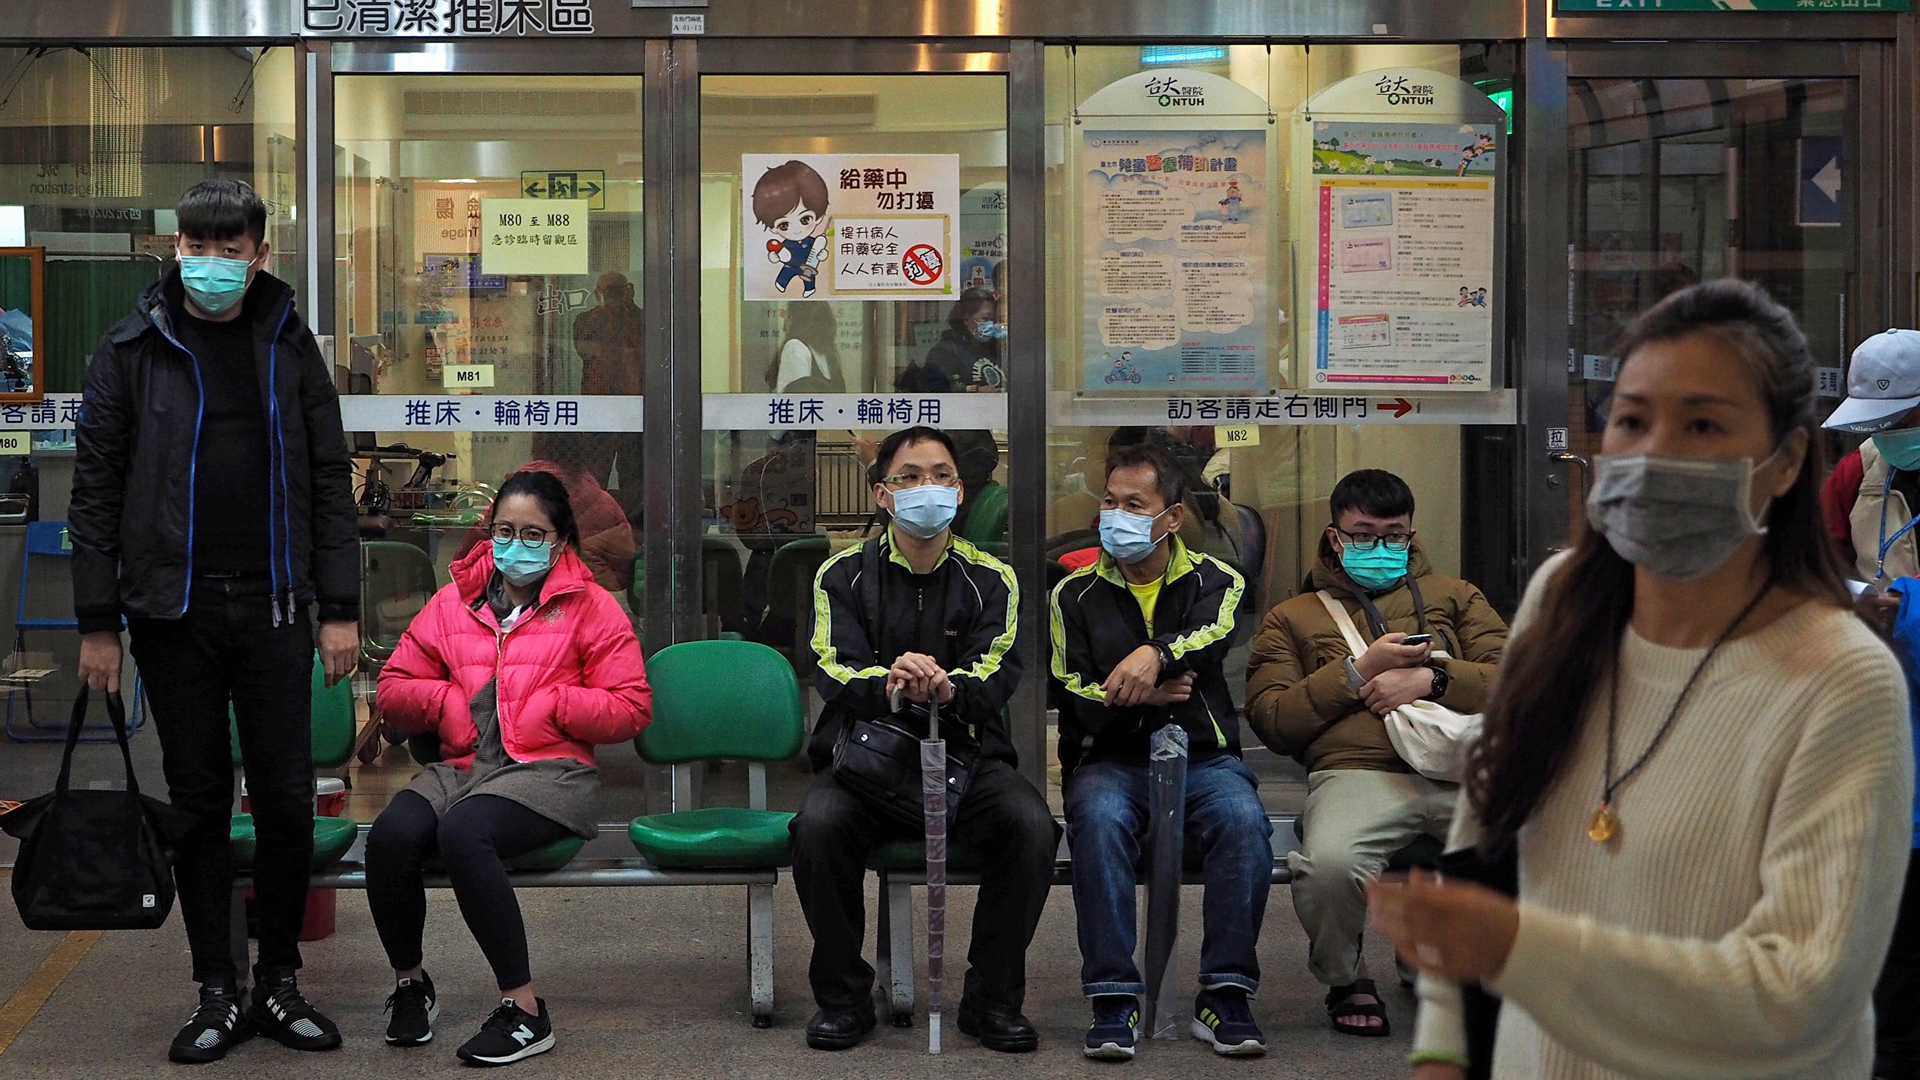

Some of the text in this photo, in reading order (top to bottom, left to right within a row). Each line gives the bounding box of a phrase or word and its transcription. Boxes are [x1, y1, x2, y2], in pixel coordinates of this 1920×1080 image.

[1172, 98, 1205, 107] NTUH
[1401, 96, 1434, 106] NTUH
[839, 167, 908, 190] 給藥中
[876, 191, 935, 210] 勿打擾
[499, 213, 570, 227] M80 至 M88
[841, 226, 899, 239] 提升病人
[491, 234, 578, 246] 急診臨時留觀區
[841, 242, 899, 256] 用藥安全
[841, 262, 899, 276] 人人有責
[456, 371, 480, 382] M81
[1167, 394, 1368, 419] 訪客請走右側門
[1226, 430, 1248, 442] M82
[1550, 430, 1563, 444] 拉
[0, 438, 18, 449] 80
